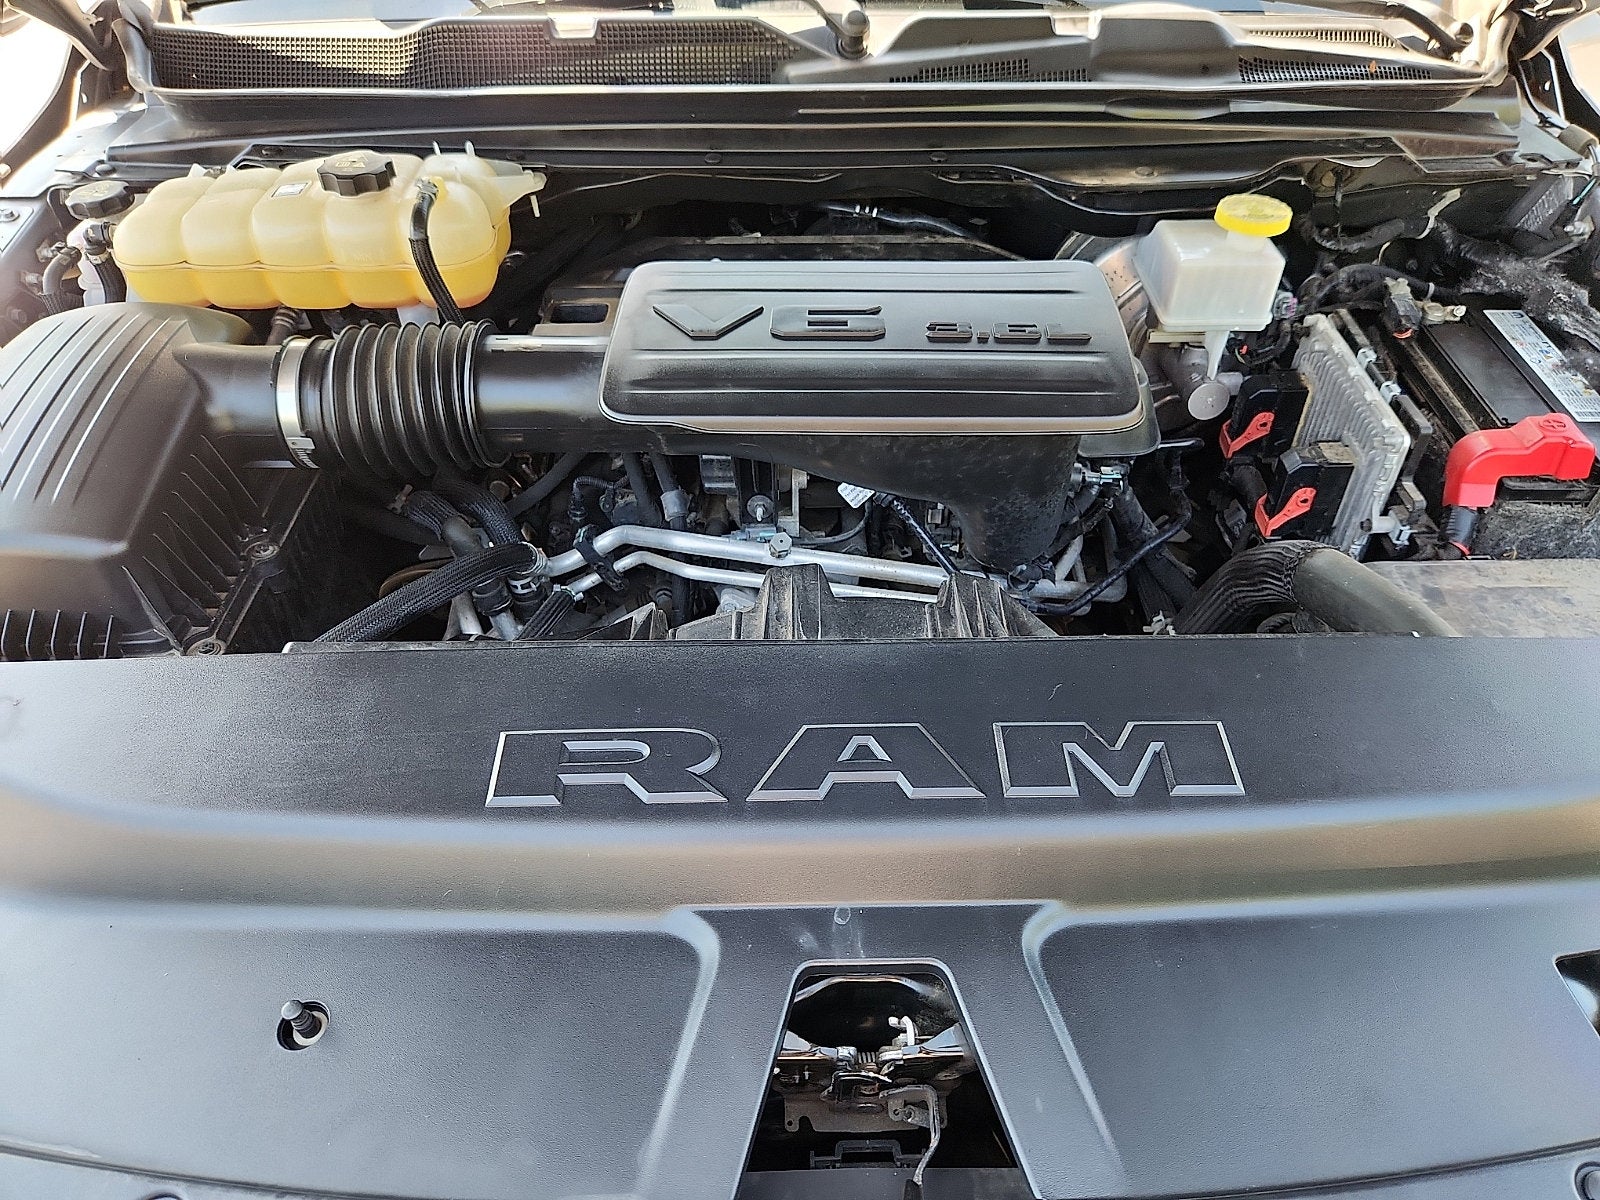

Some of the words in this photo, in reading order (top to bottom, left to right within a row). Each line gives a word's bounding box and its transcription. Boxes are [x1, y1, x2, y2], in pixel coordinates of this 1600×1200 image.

[652, 304, 887, 341] V6
[924, 320, 1092, 343] 3.6L
[485, 720, 1246, 807] RAM
